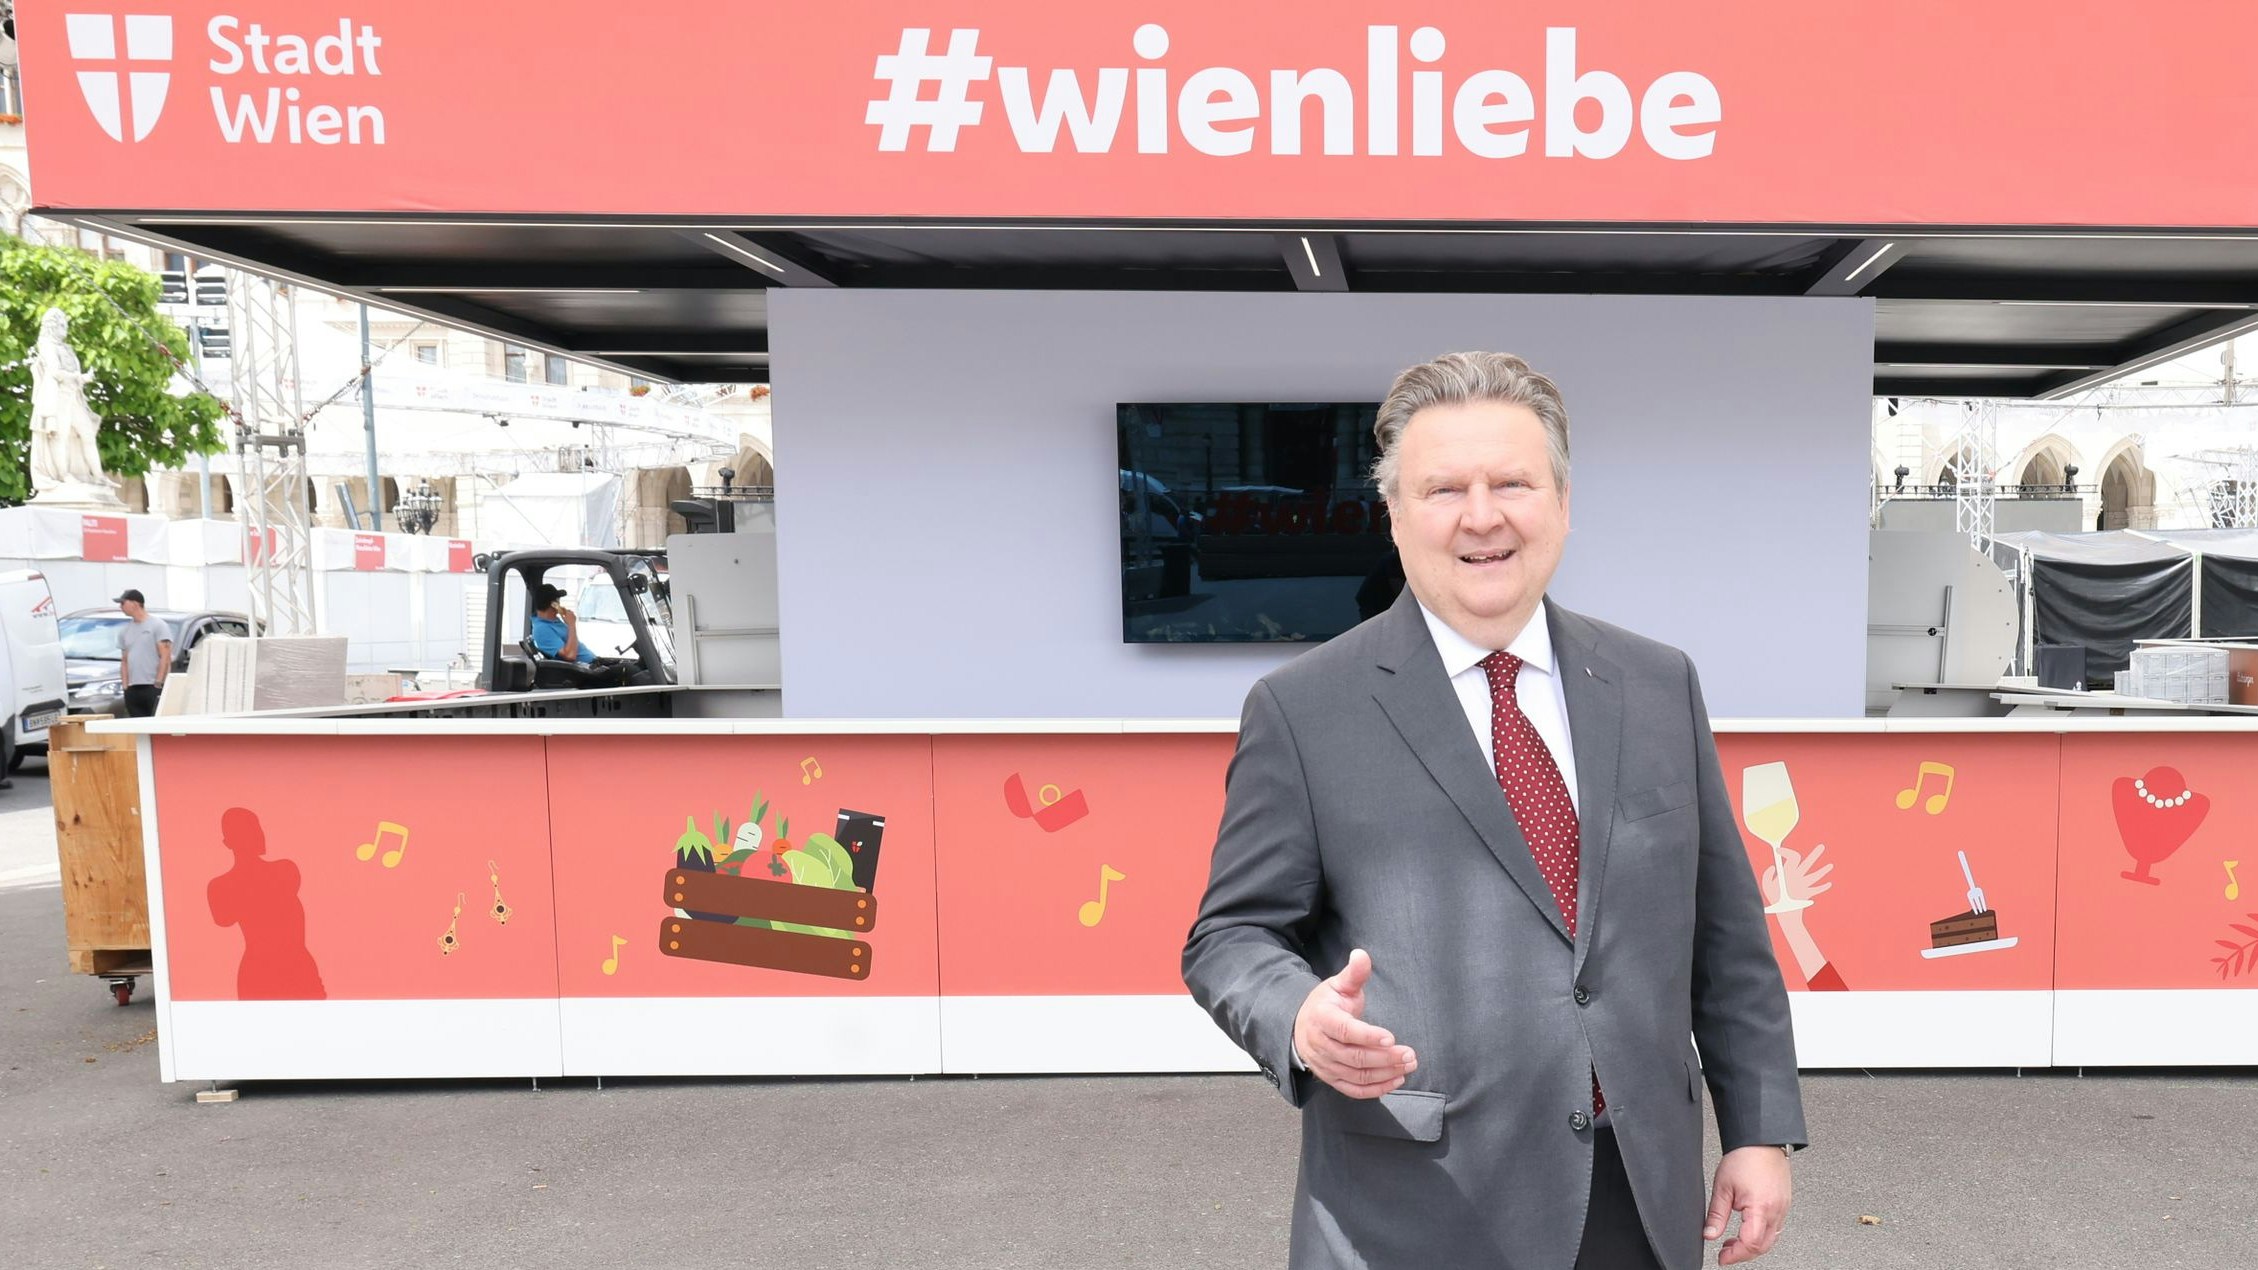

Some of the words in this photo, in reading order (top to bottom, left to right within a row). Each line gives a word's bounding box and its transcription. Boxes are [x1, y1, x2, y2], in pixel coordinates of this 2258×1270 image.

[208, 15, 381, 75] Stadt
[210, 87, 385, 144] Wien
[865, 24, 1721, 160] #wienliebe
